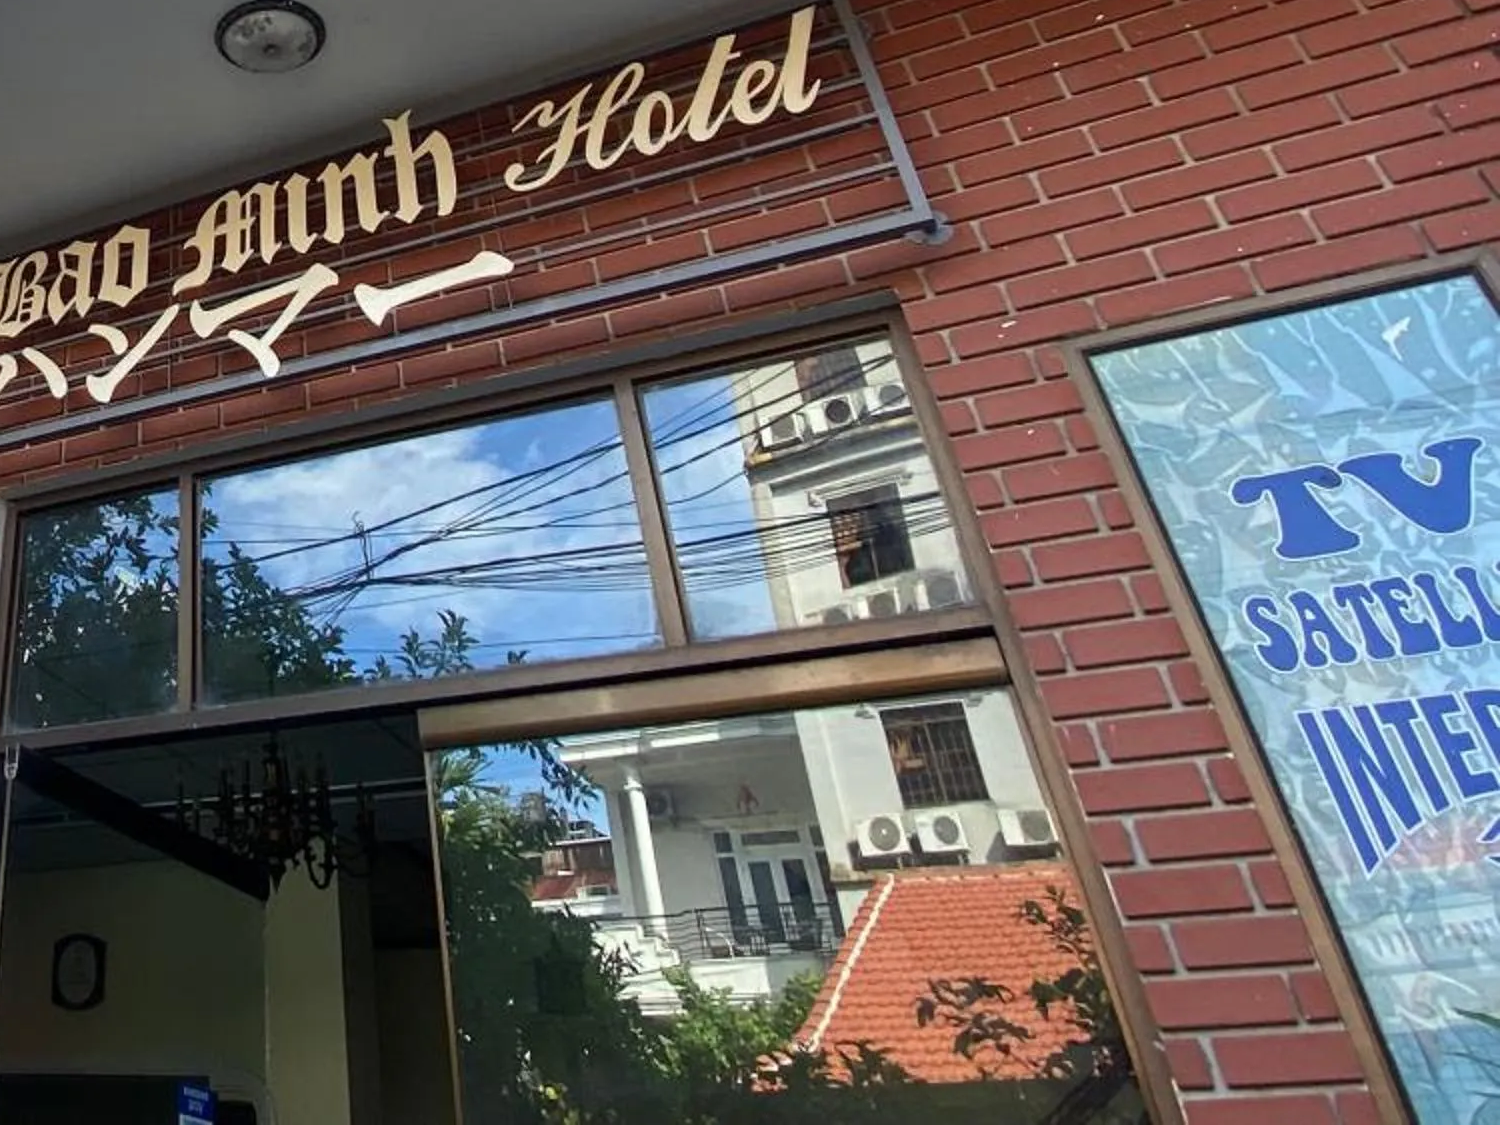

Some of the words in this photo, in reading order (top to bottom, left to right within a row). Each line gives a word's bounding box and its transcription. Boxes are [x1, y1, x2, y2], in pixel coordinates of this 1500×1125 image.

[172, 108, 458, 293] Minh
[504, 6, 821, 192] Hotel
[1228, 435, 1485, 562] TV
[1242, 559, 1500, 674] SATELL
